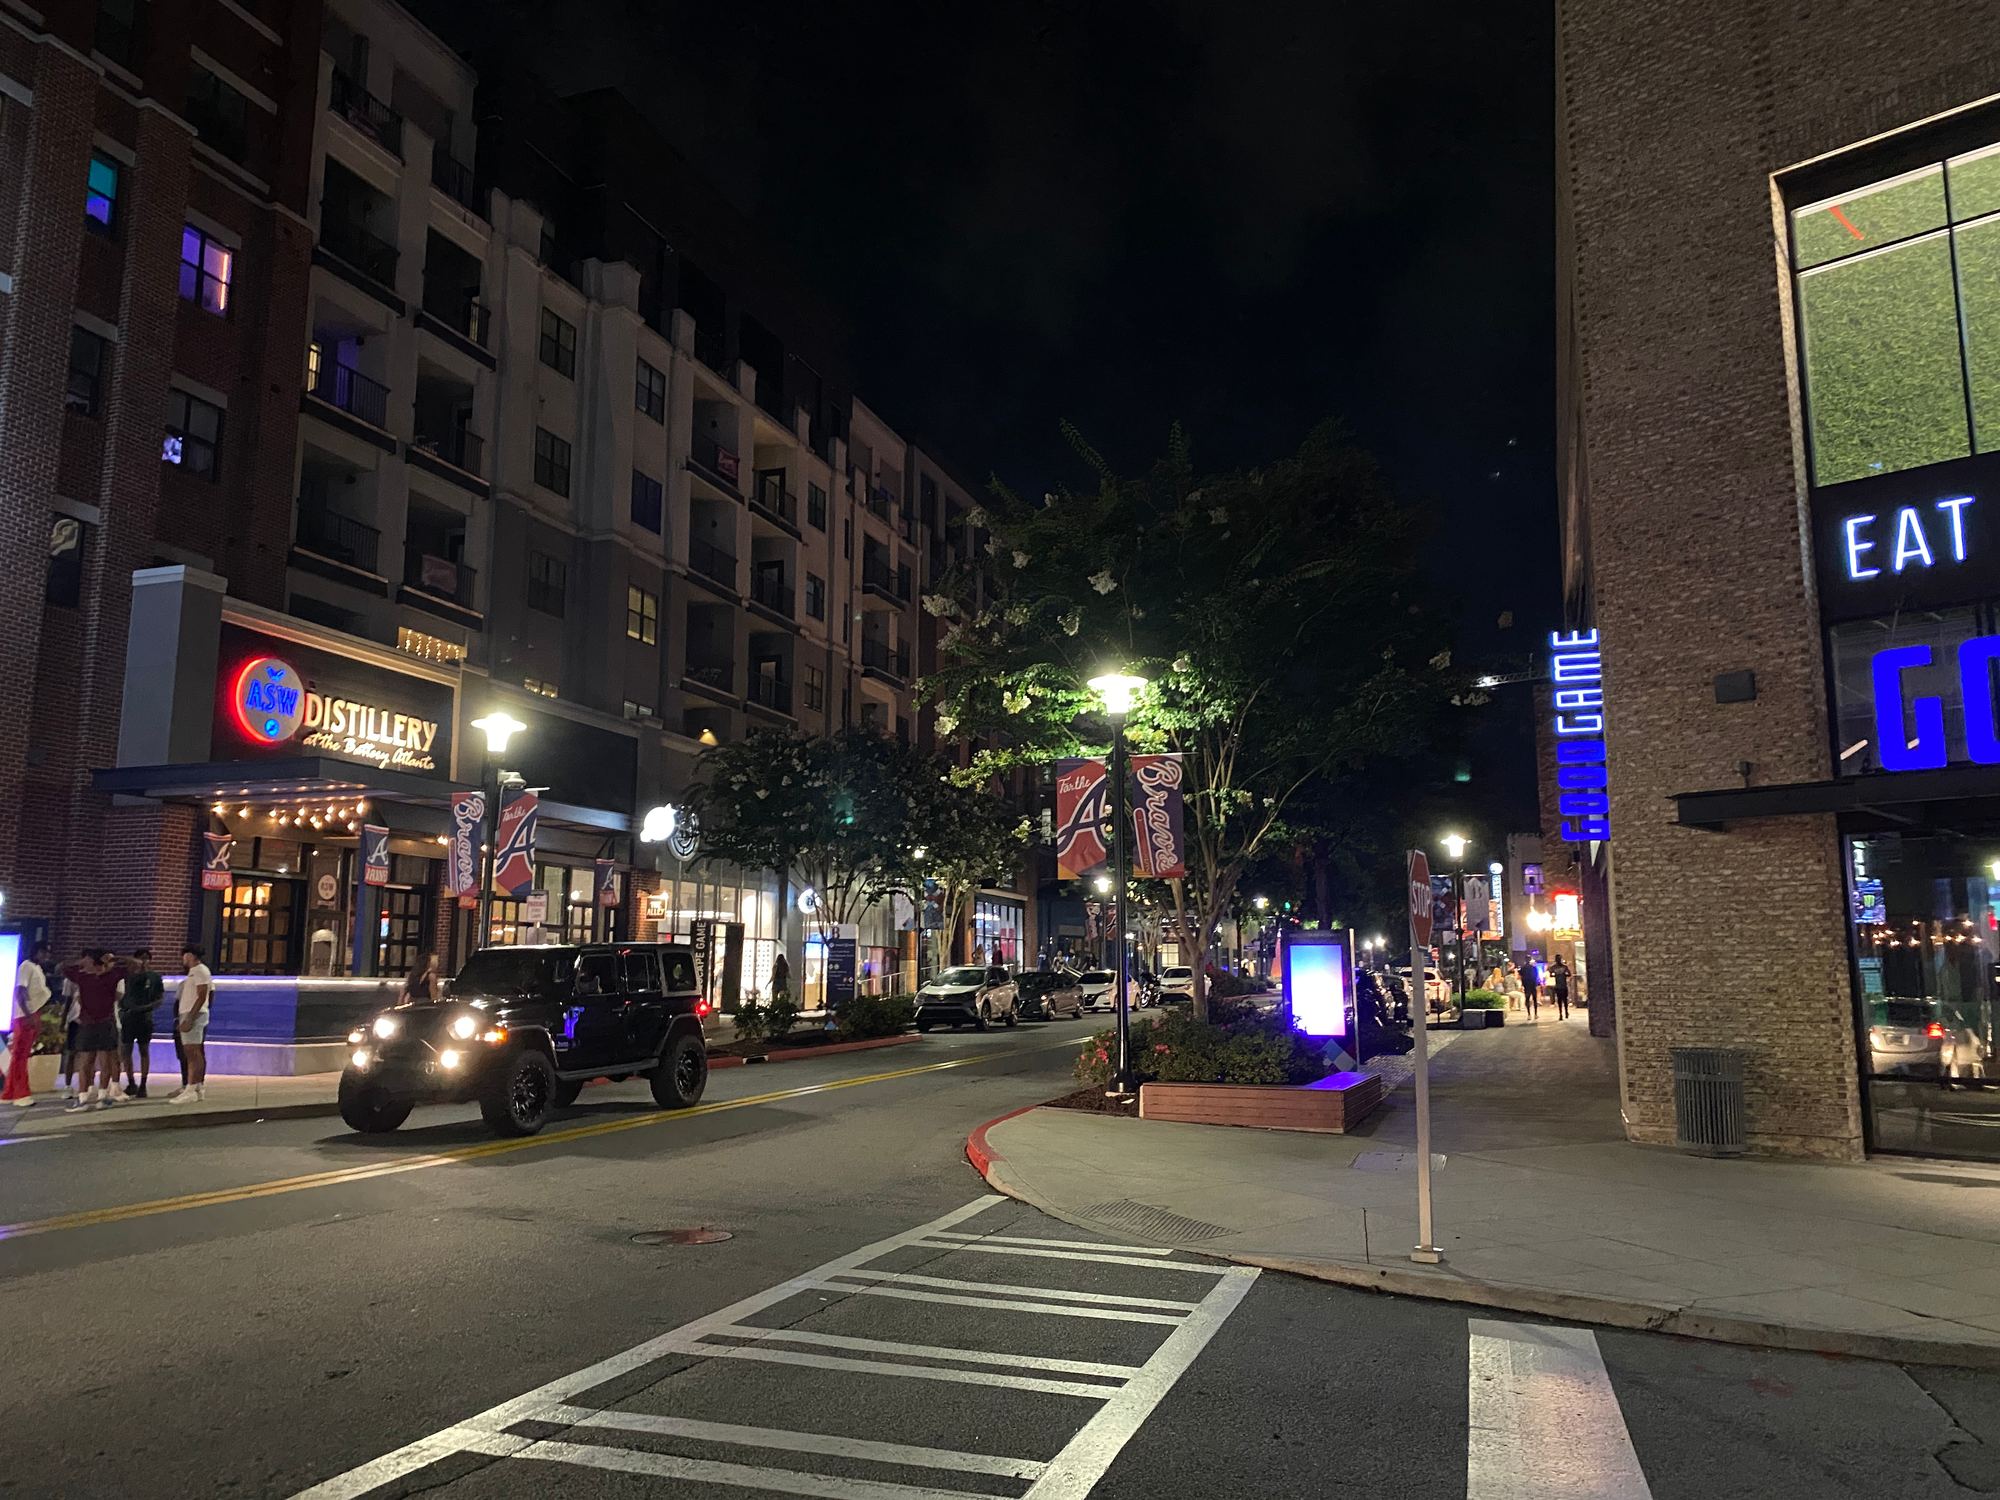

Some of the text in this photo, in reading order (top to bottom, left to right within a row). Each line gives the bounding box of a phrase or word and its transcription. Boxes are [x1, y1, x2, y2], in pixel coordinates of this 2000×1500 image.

[1846, 495, 1975, 578] EAT
[246, 678, 300, 717] ASW
[304, 692, 438, 752] DISTILLERY
[1552, 628, 1611, 842] GOOD GAME
[343, 737, 390, 769] Battery
[391, 747, 436, 770] Atlanta
[207, 842, 231, 870] A
[367, 836, 388, 865] A
[646, 908, 666, 916] ALLEY
[1412, 880, 1431, 918] STOP
[695, 921, 707, 988] SCAPE GAME
